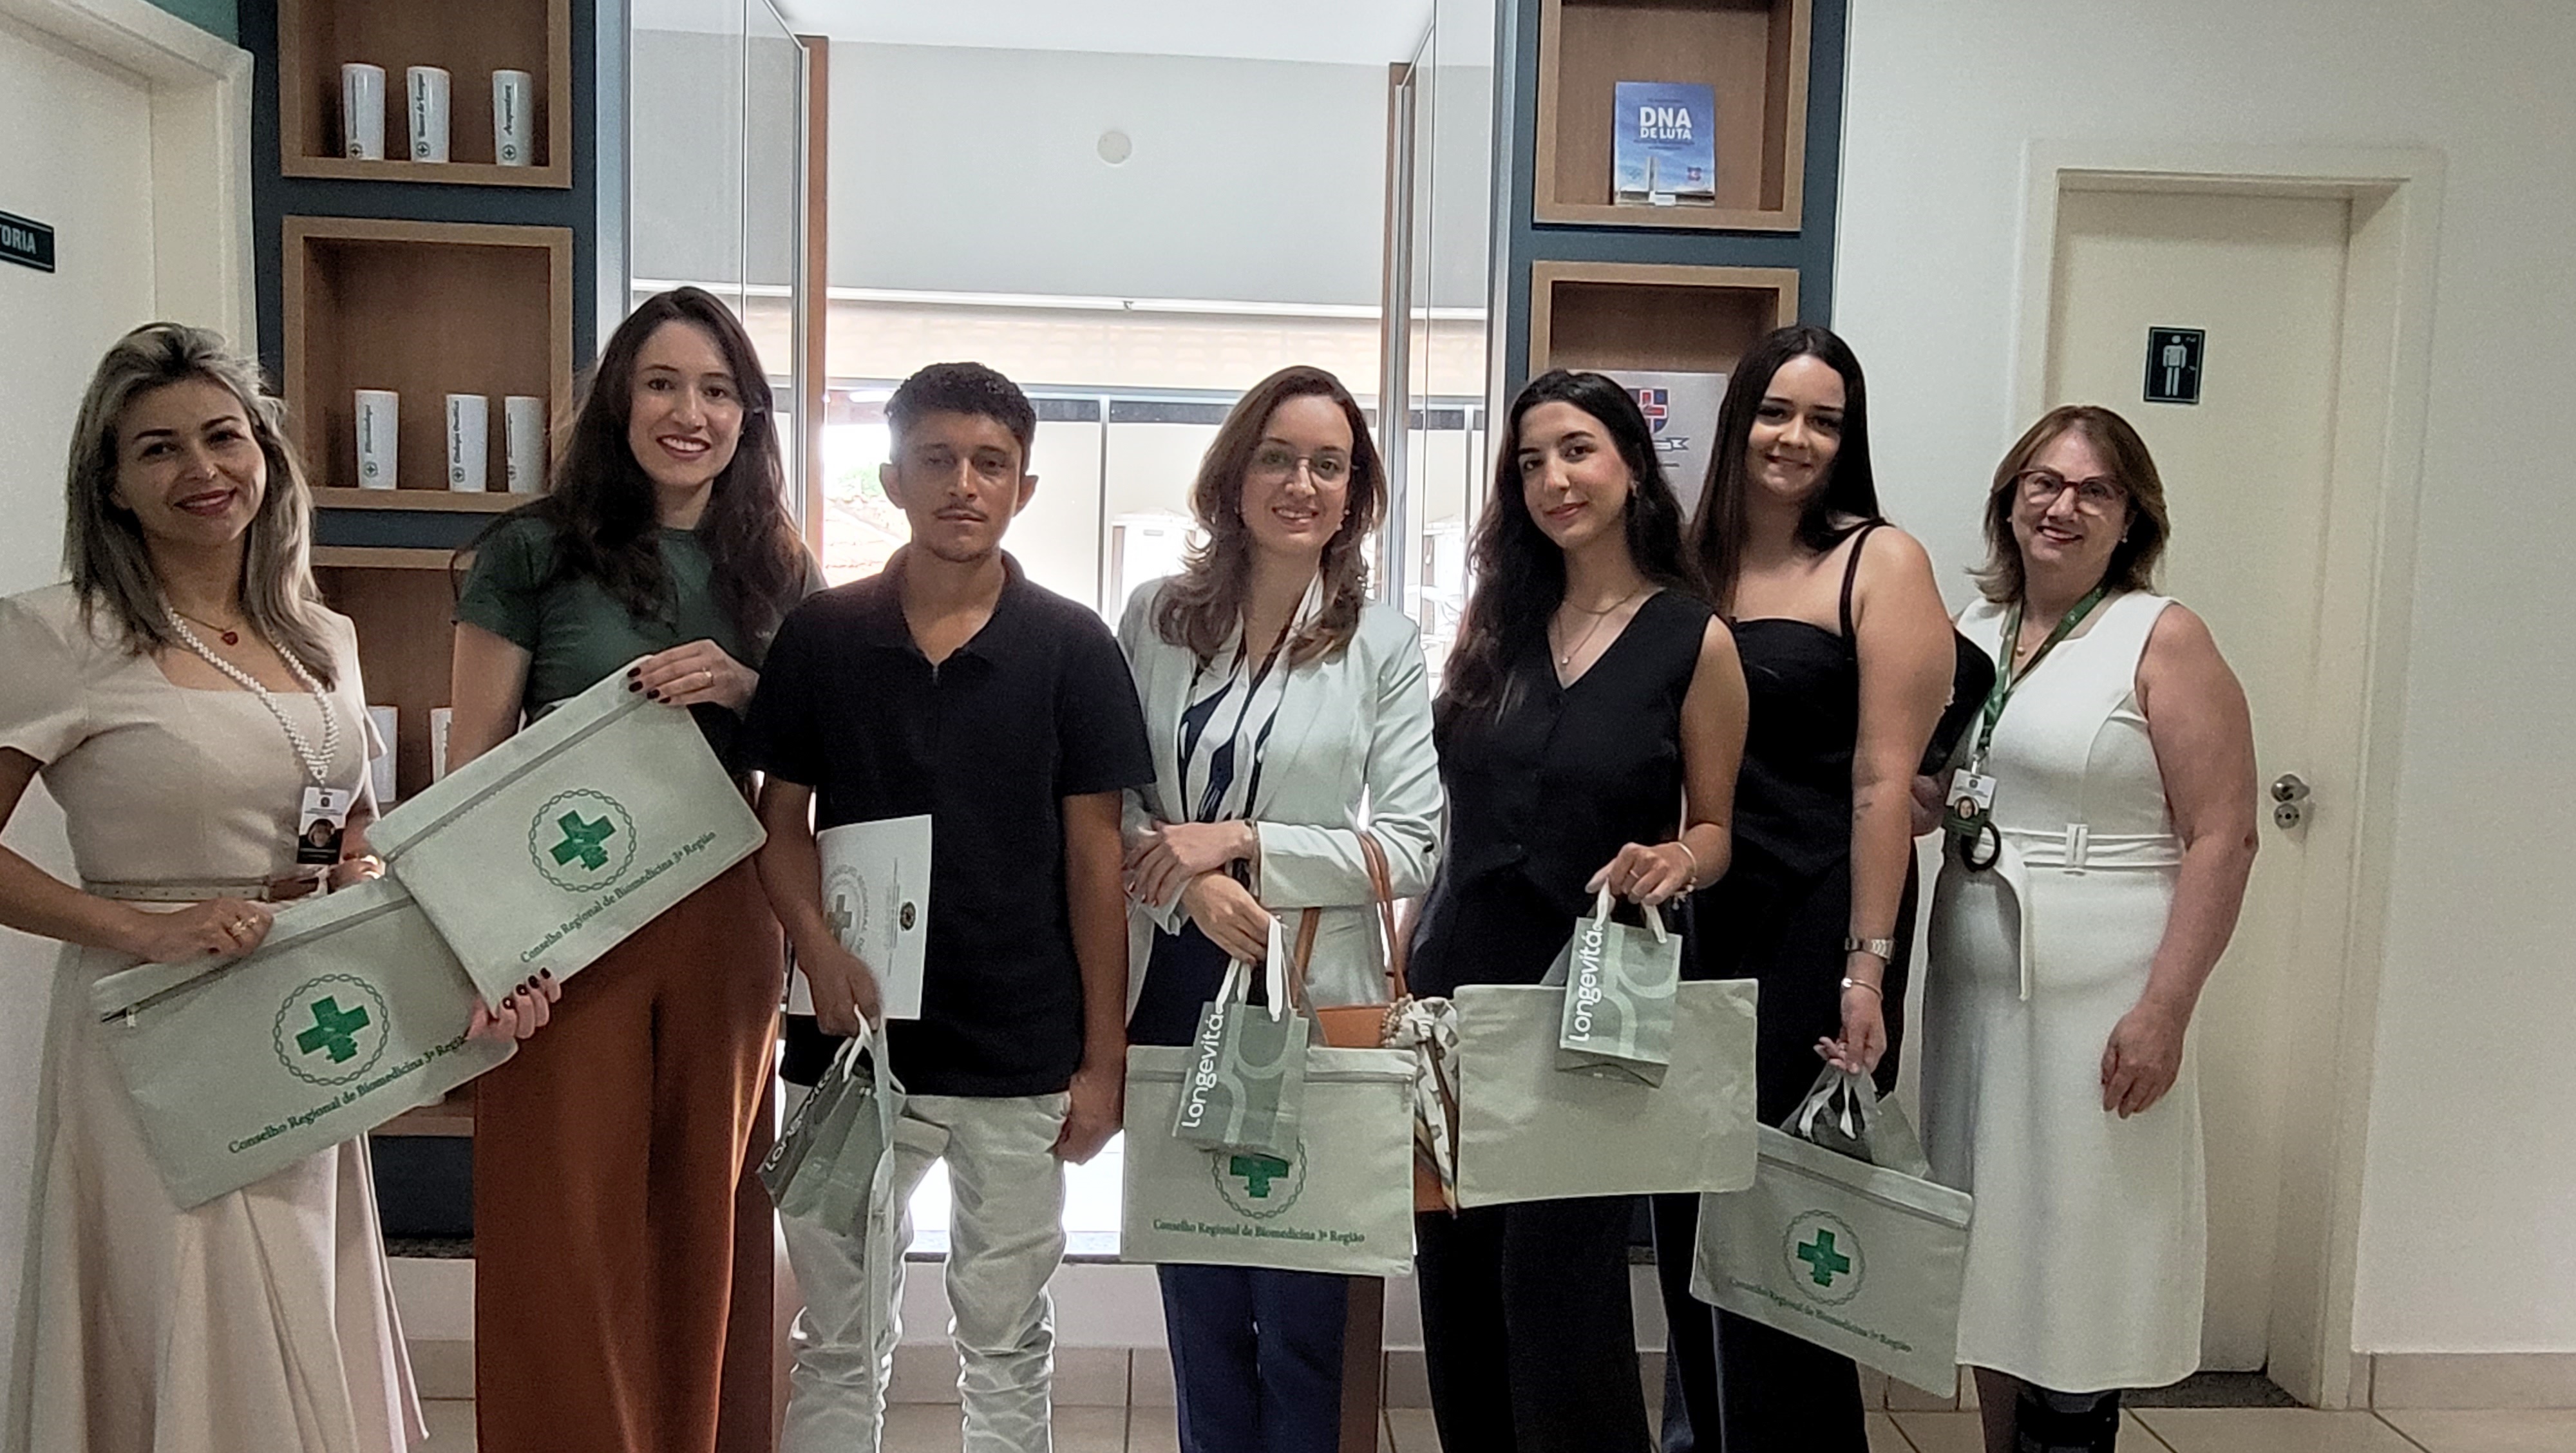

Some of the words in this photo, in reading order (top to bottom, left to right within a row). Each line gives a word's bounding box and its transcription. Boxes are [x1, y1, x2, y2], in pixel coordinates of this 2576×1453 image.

[1640, 106, 1692, 128] DNA
[1640, 128, 1658, 139] DE
[1659, 128, 1692, 140] LUTA
[0, 223, 37, 254] ORIA
[520, 931, 563, 963] Conselho
[560, 900, 603, 934] Regional
[602, 894, 616, 907] de
[613, 859, 674, 899] Biomedicina
[682, 831, 717, 856] Região
[228, 1124, 287, 1154] Conselho
[287, 1096, 343, 1129] Regional
[341, 1090, 357, 1105] de
[355, 1059, 424, 1097] Biomedicina
[1255, 1226, 1315, 1240] Biomedicina
